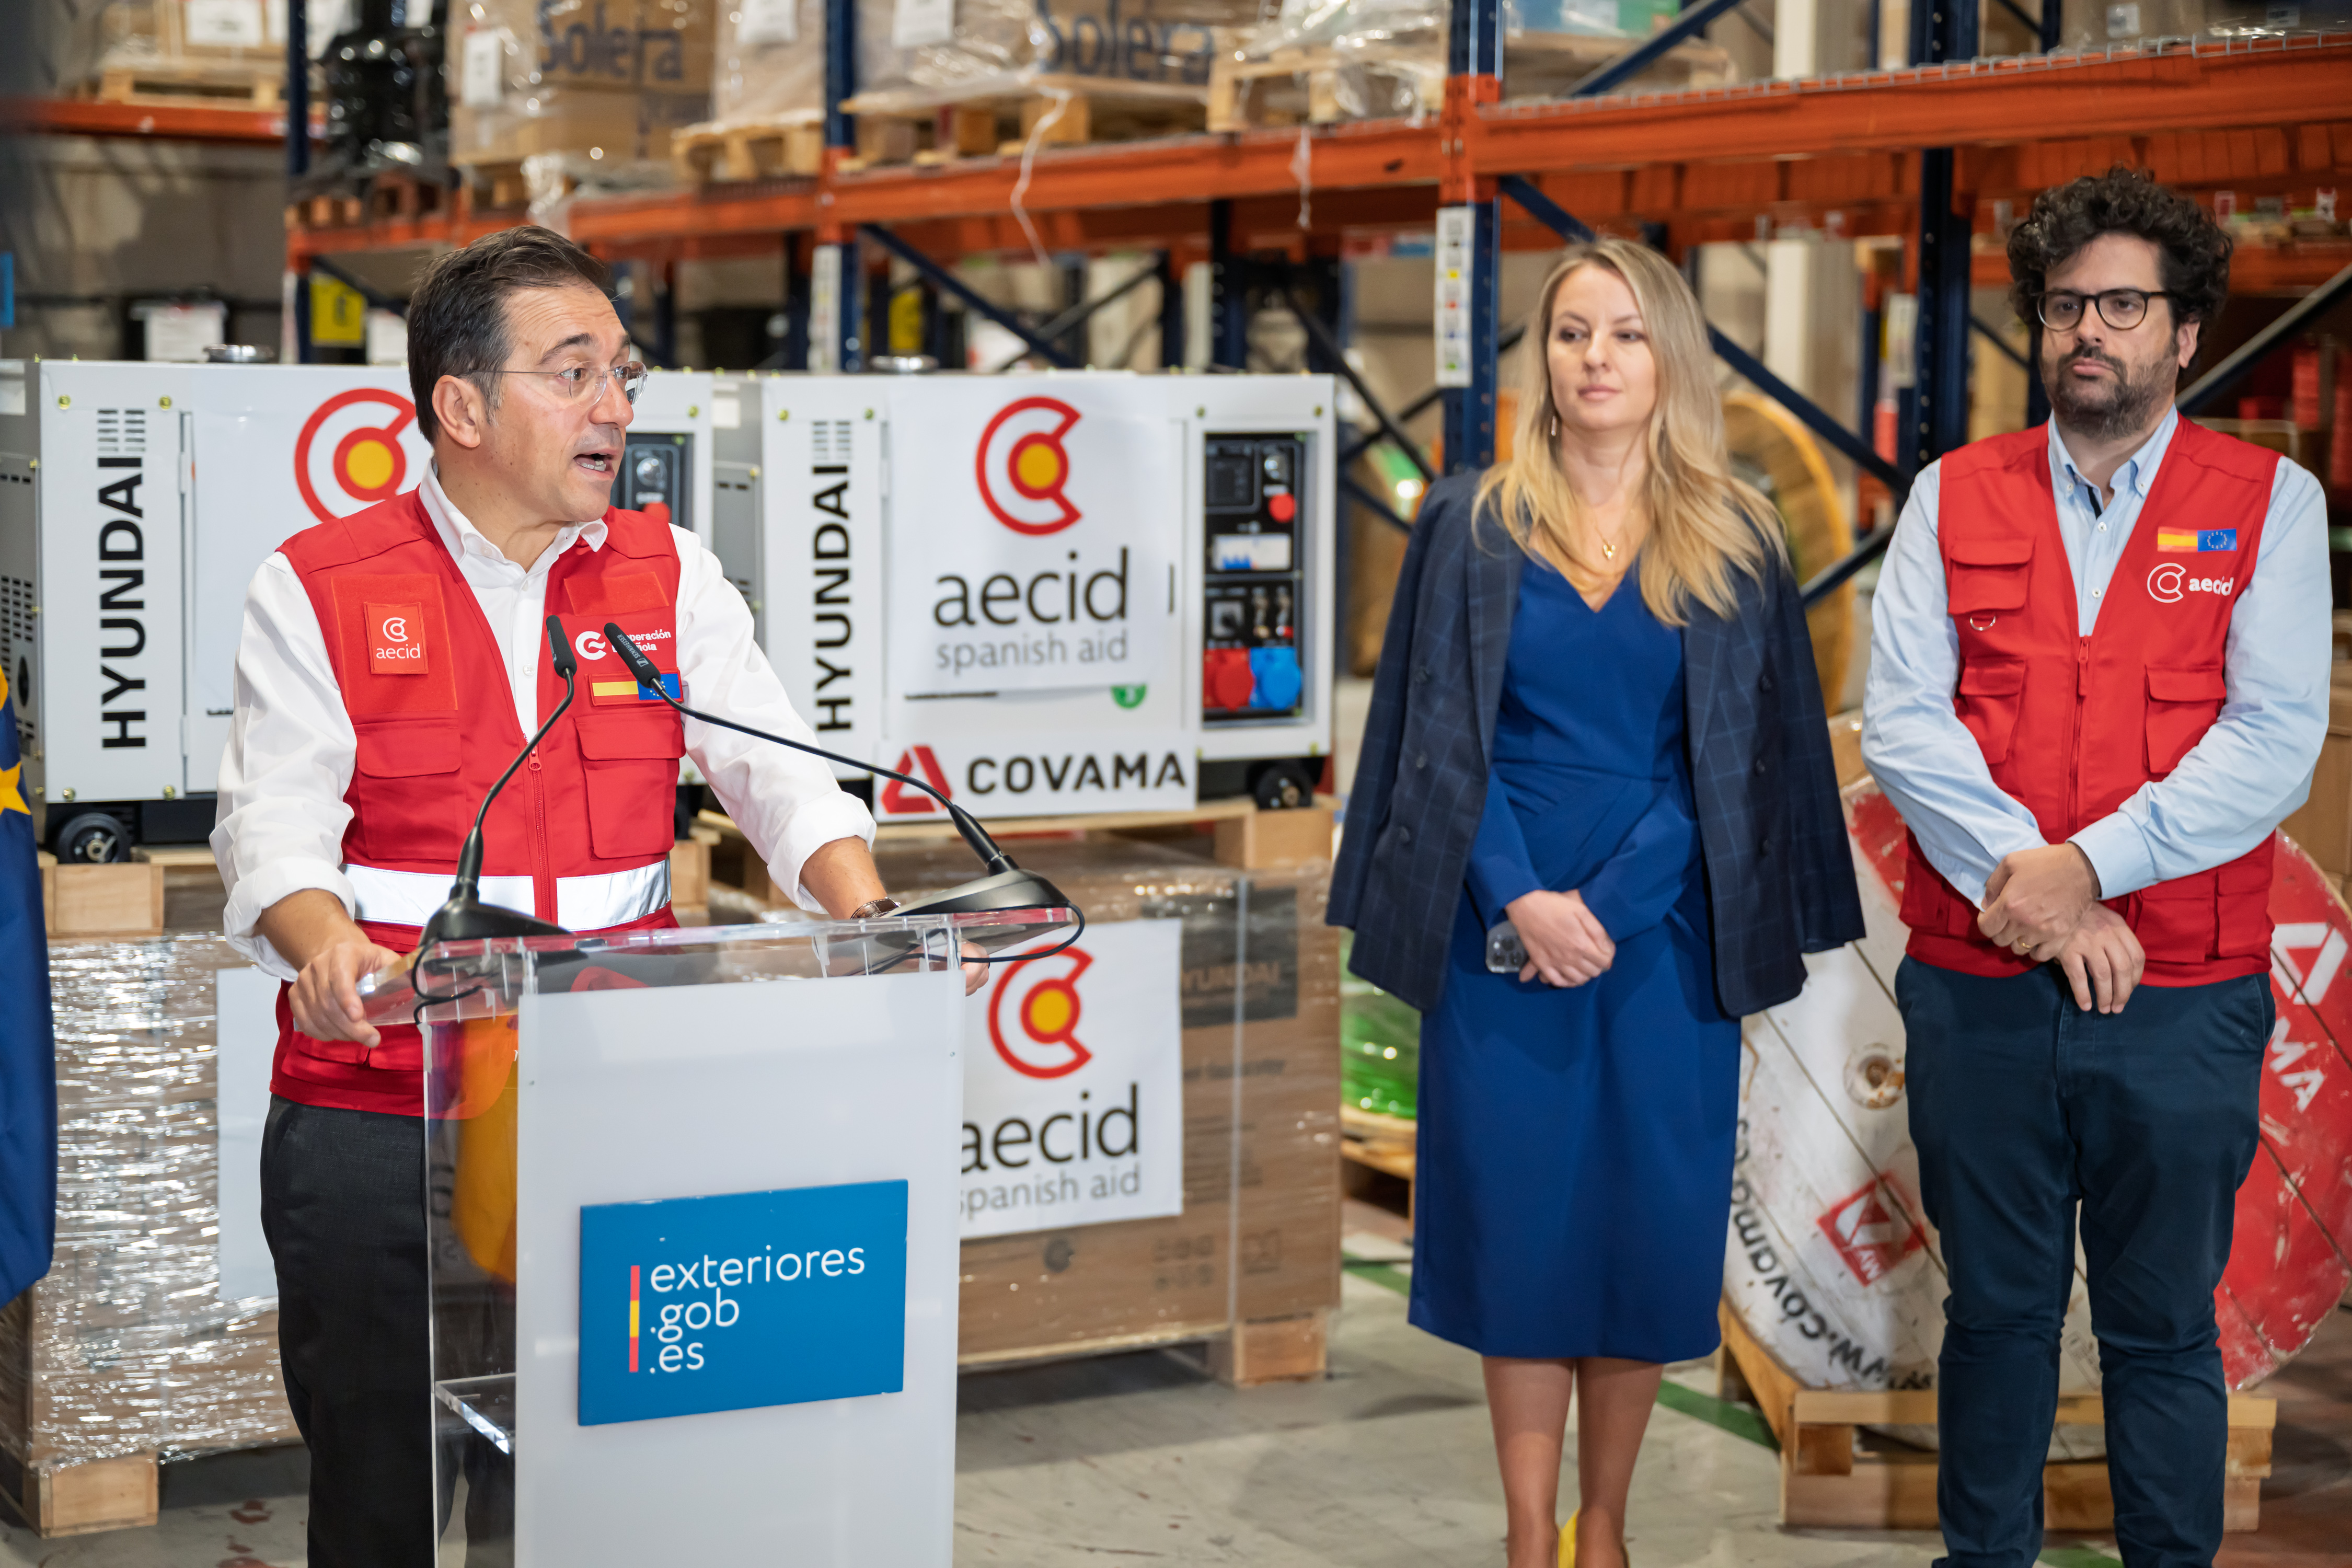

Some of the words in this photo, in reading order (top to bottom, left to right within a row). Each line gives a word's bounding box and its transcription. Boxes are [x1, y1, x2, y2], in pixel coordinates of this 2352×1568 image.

[537, 0, 684, 82] Solera
[98, 457, 147, 748] HYUNDAI
[812, 466, 852, 731] HYUNDAI
[933, 546, 1128, 627] aecid
[376, 643, 421, 659] aecid
[617, 634, 641, 659] SENNHEISER
[937, 632, 1067, 676] spanish
[1077, 629, 1128, 663] aid
[967, 752, 1186, 794] COVAMA
[961, 1081, 1138, 1174] aecid
[960, 1169, 1079, 1221] panish
[1089, 1162, 1140, 1200] aid
[650, 1244, 866, 1293] exteriores
[650, 1287, 740, 1343] .gob
[649, 1342, 705, 1374] .es
